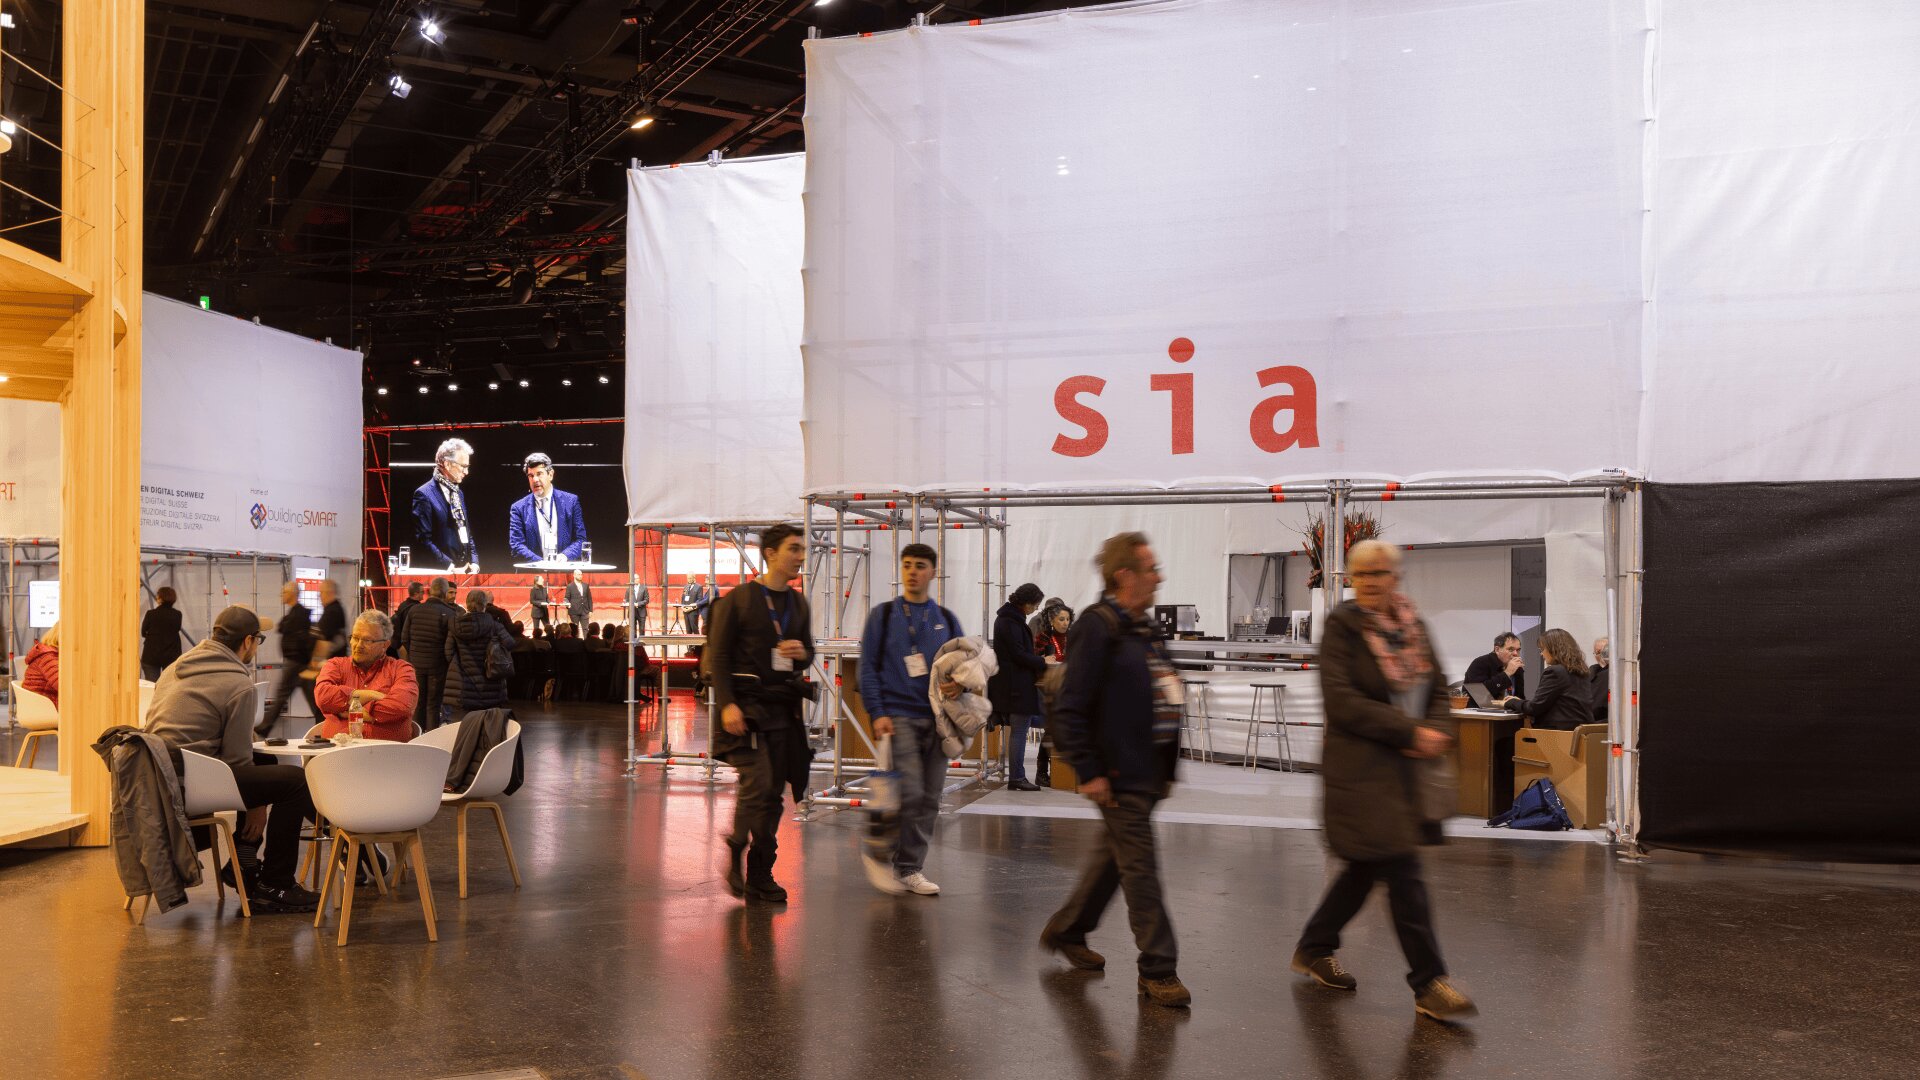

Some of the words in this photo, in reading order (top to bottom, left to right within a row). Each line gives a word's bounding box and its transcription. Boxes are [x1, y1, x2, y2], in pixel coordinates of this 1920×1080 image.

[1051, 337, 1320, 458] sia
[150, 486, 174, 497] DIGITAL
[176, 490, 204, 500] SCHWEIZ
[145, 496, 166, 506] DIGITAL
[168, 500, 188, 509] SUISSE
